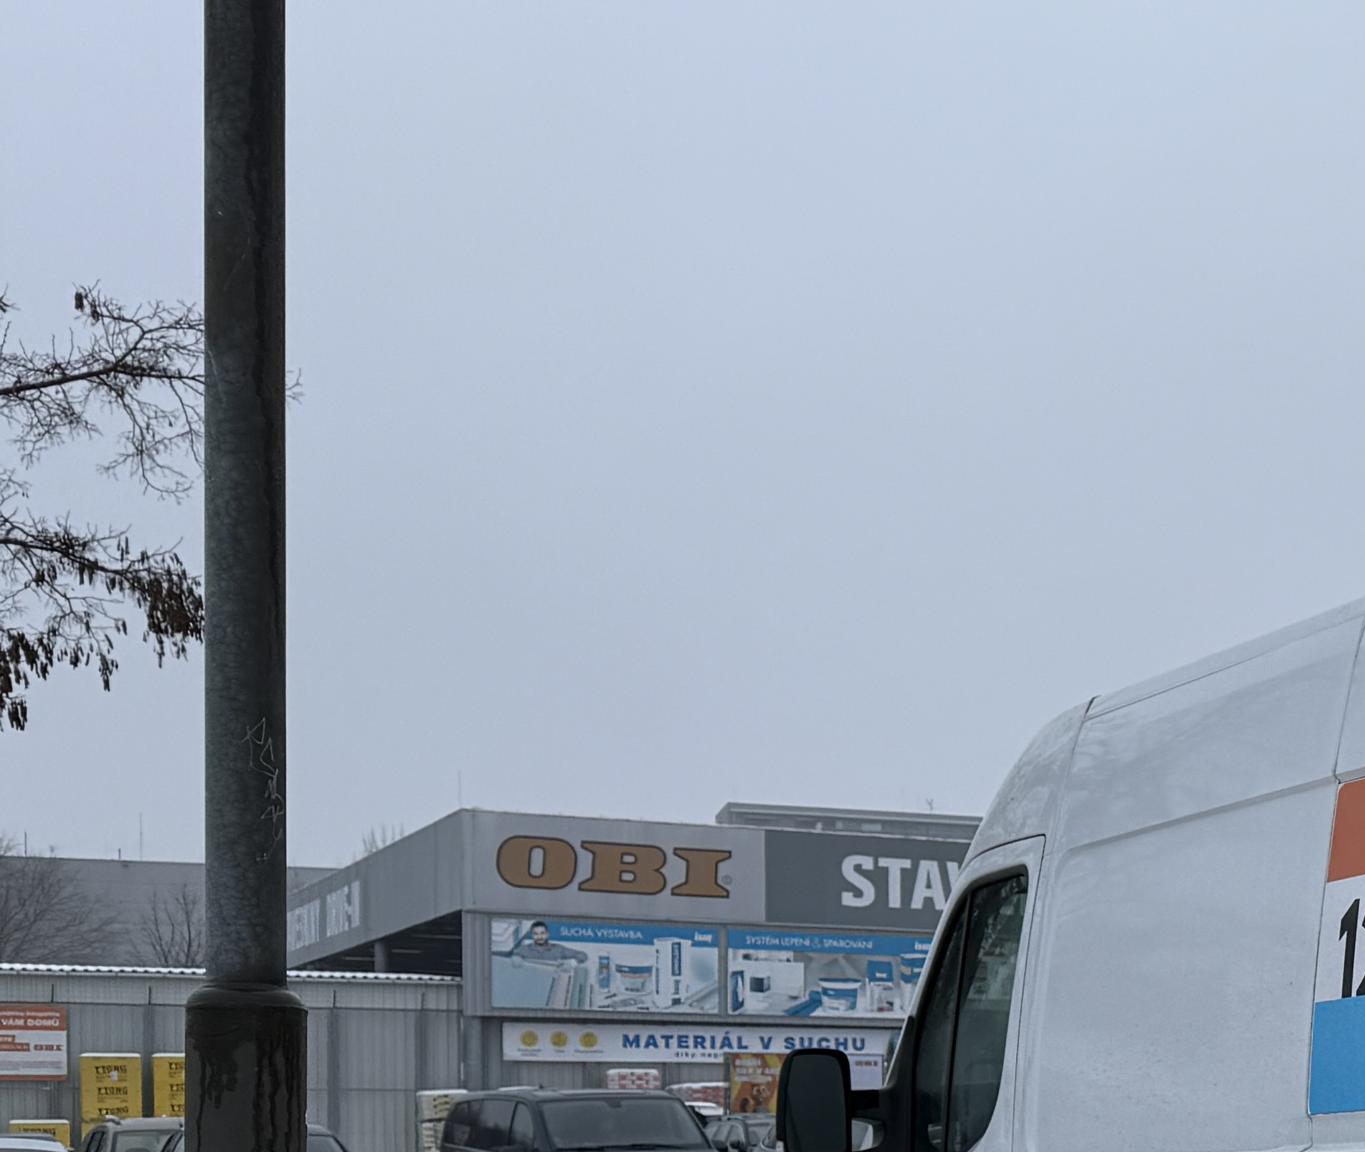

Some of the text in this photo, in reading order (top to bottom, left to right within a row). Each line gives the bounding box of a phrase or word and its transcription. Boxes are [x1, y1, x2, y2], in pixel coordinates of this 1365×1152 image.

[496, 835, 732, 899] OBI
[622, 1030, 866, 1051] MATERIÁL V SUCHU
